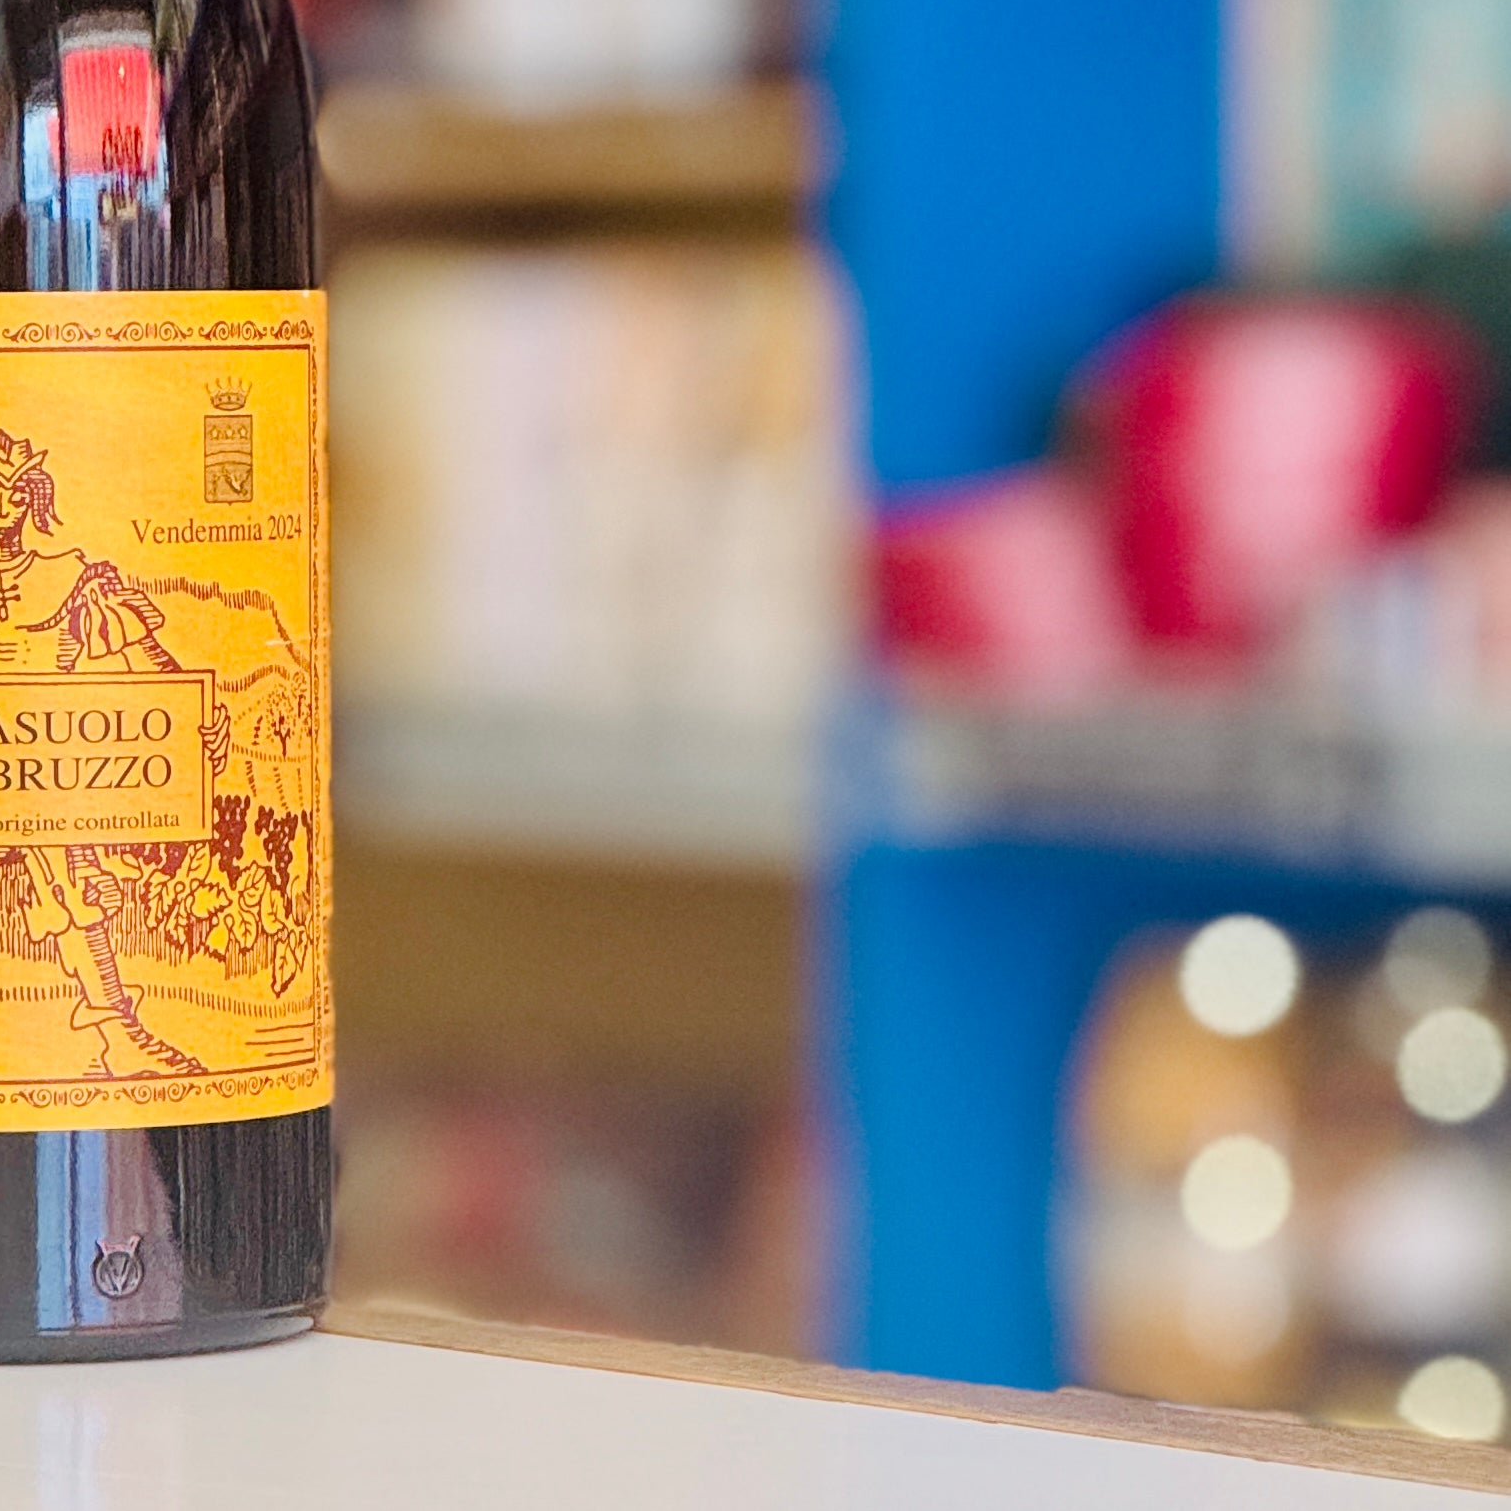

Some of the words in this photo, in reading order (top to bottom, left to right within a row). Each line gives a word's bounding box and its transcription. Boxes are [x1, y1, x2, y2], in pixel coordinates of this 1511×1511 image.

[130, 515, 263, 545] Vendemmia
[267, 513, 303, 541] 2024
[73, 810, 181, 832] controllata
